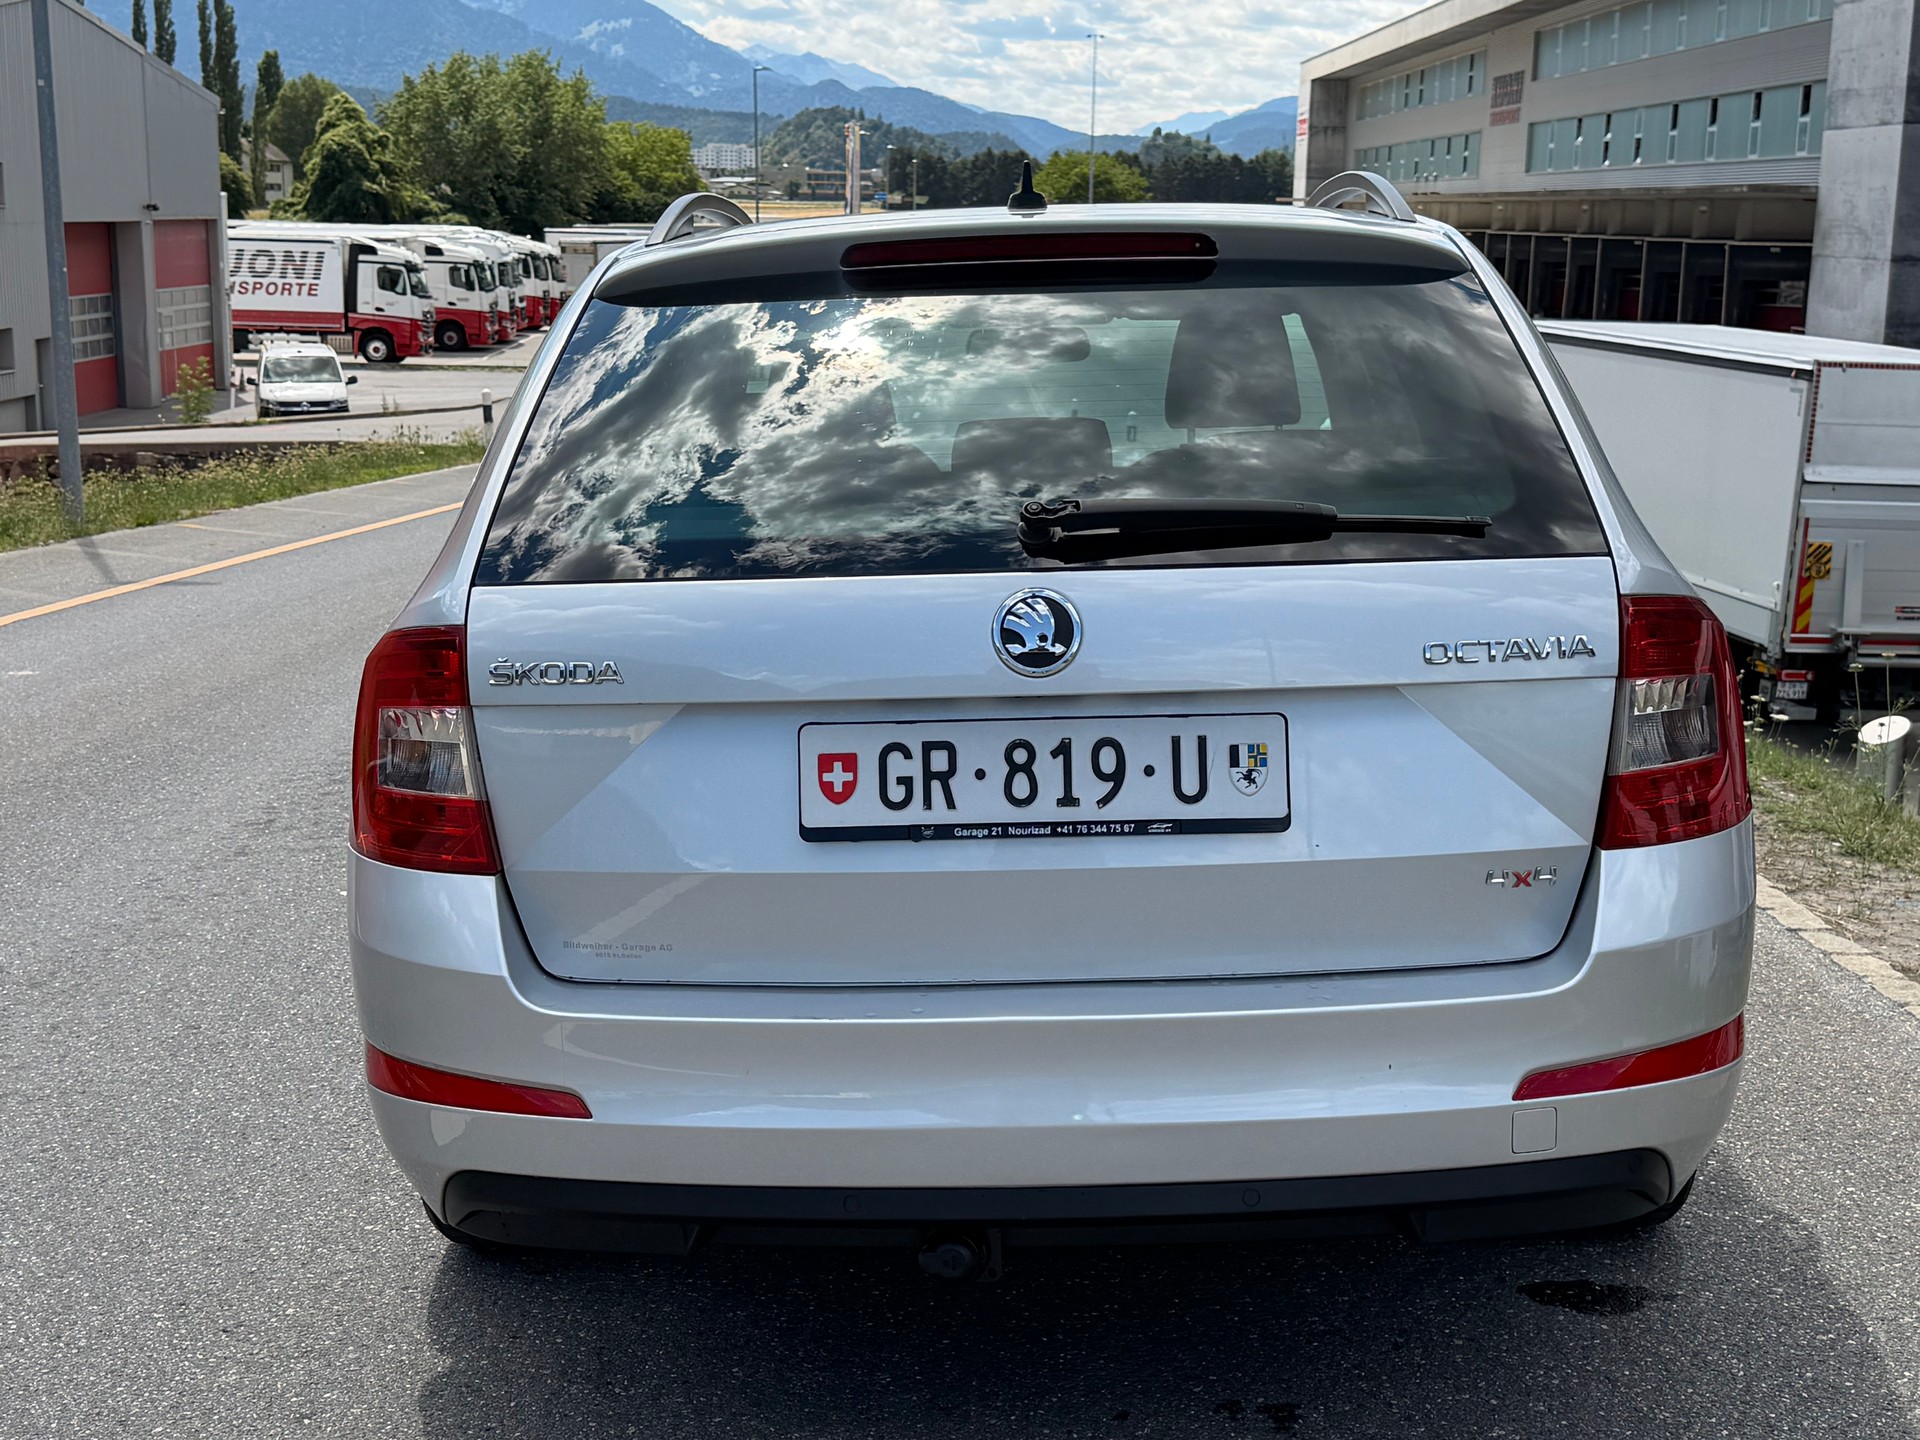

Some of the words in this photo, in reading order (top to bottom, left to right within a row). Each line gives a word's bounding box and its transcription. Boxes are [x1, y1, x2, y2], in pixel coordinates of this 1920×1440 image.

[1422, 634, 1596, 665] OCTAVIA
[489, 657, 624, 685] ŠKODA
[954, 827, 989, 838] Garage
[991, 827, 1002, 836] 21
[1008, 825, 1051, 835] Nourizad
[1056, 825, 1073, 834] +41
[1076, 825, 1088, 834] 76
[1090, 824, 1107, 833] 344
[1109, 824, 1121, 833] 75
[621, 942, 657, 953] Garage
[659, 943, 673, 952] AG
